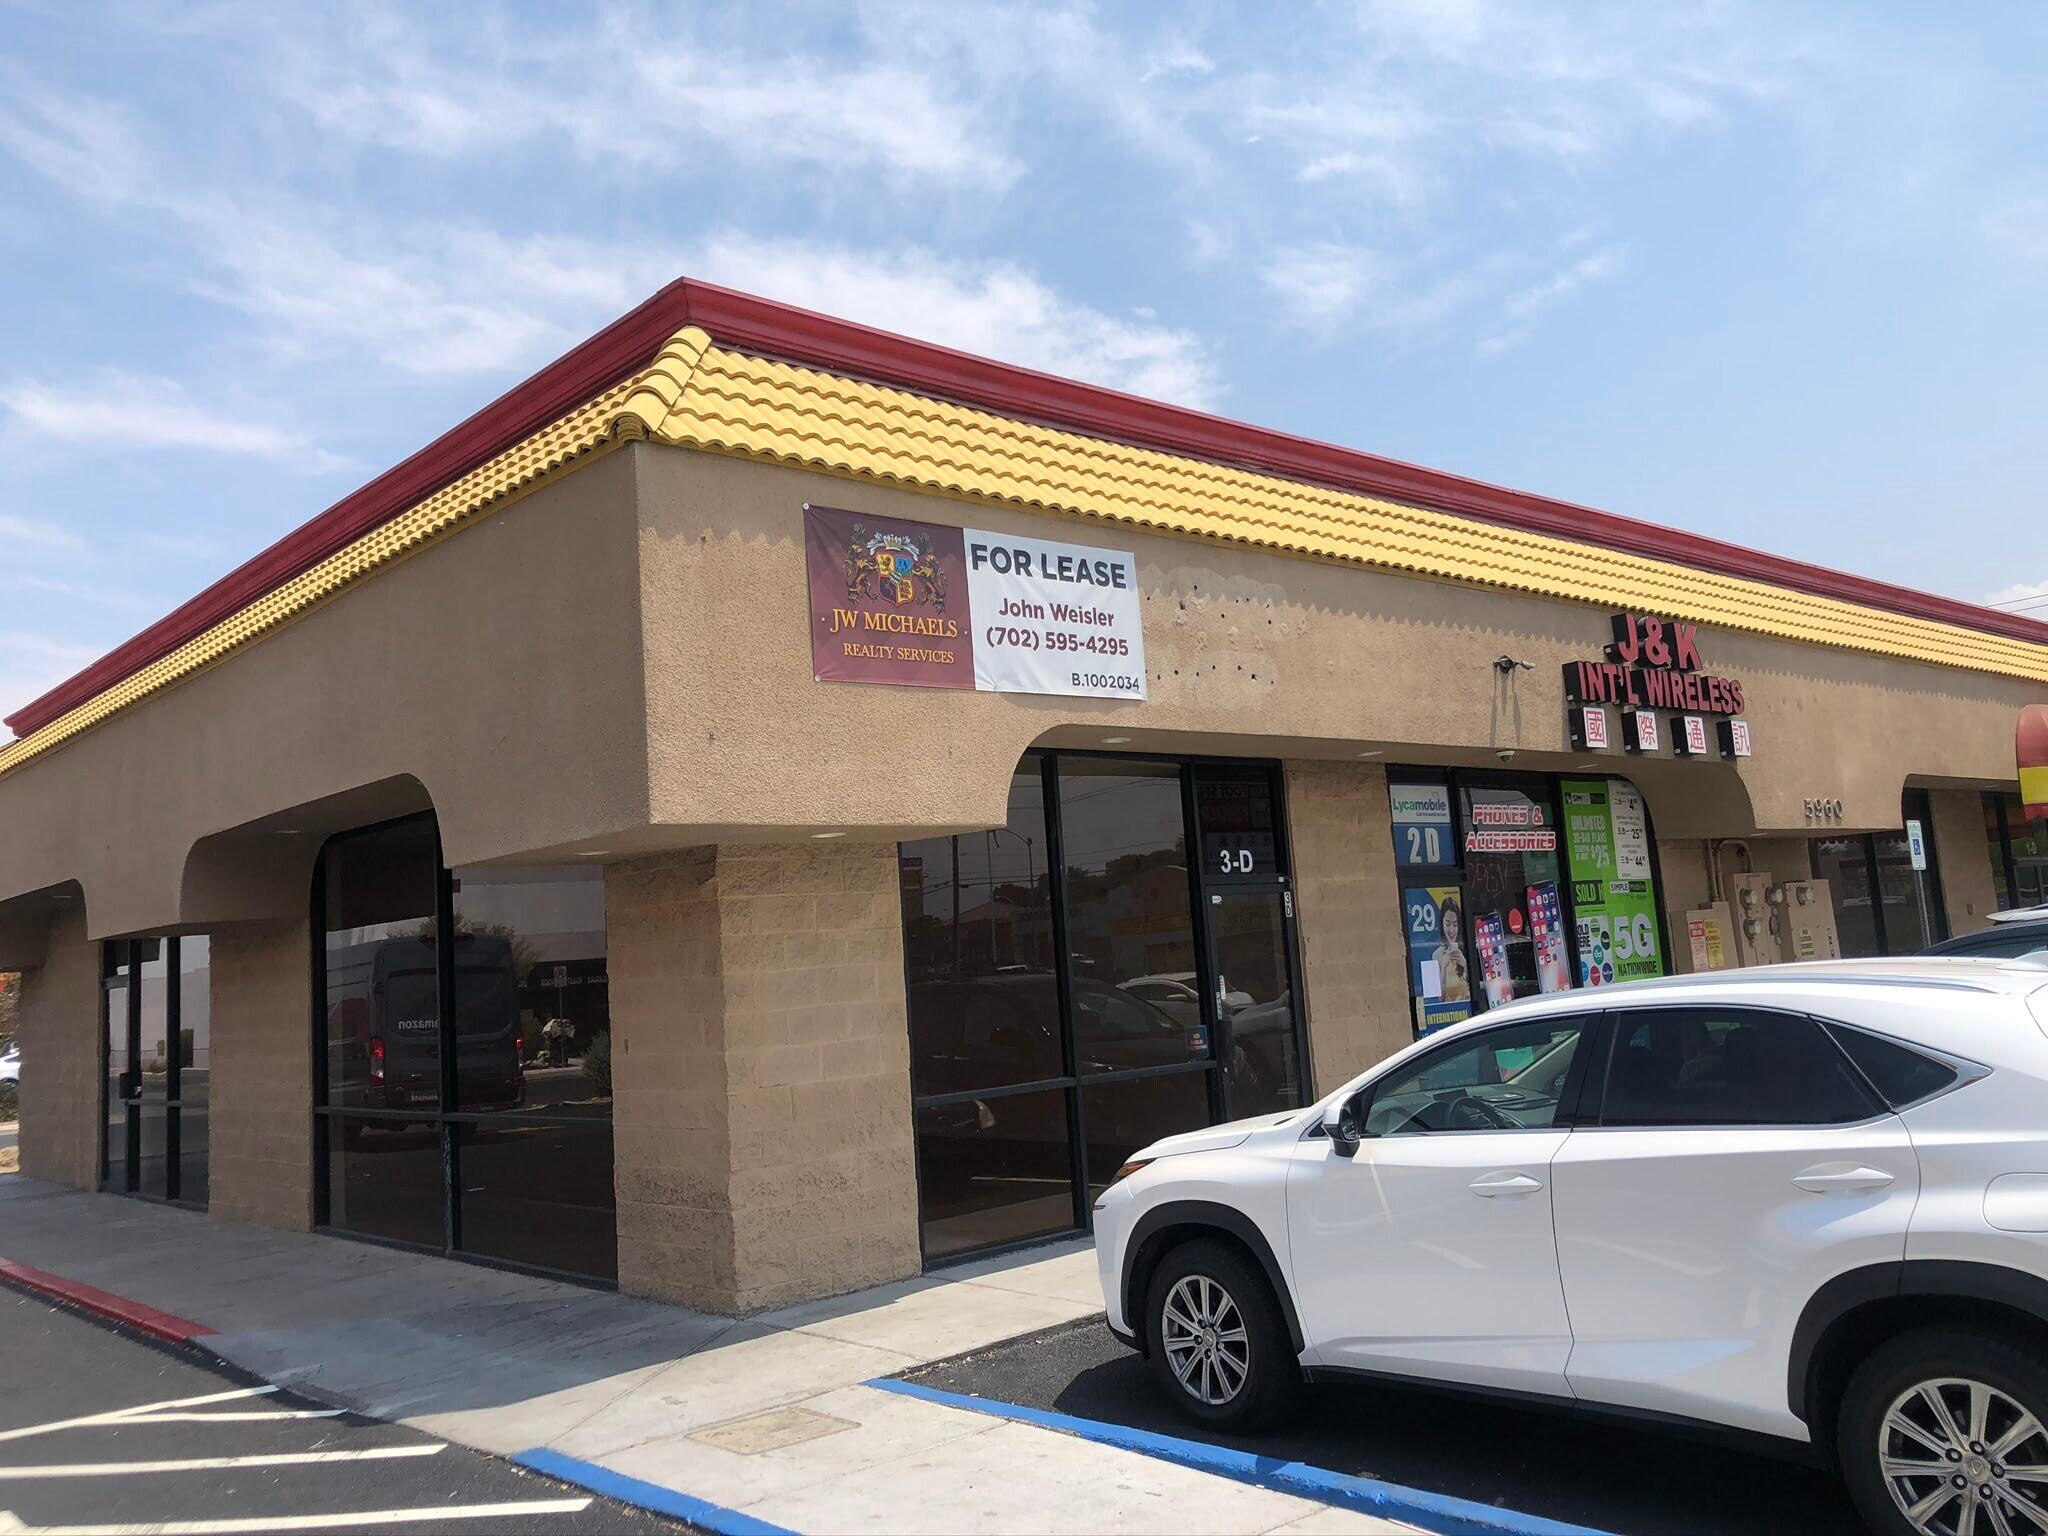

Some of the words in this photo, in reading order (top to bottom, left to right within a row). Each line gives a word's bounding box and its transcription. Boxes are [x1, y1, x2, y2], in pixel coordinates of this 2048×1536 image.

[970, 543, 1033, 578] FOR
[1040, 552, 1126, 590] LEASE
[998, 597, 1045, 620] John
[1049, 602, 1115, 627] Weisler
[829, 608, 858, 633] JW
[863, 611, 958, 638] MICHAELS
[986, 626, 1040, 651] (702)
[1045, 632, 1129, 656] 595-4295
[843, 642, 894, 659] REALTY
[897, 647, 955, 664] SERVICES
[1071, 672, 1140, 690] B.1002034
[1577, 661, 1640, 705] INT'L
[1643, 667, 1746, 716] WIRELESS
[1392, 798, 1446, 812] Lycamobile
[1473, 804, 1528, 825] PHONES
[1532, 805, 1544, 825] &
[1465, 831, 1556, 852] ACCESSORIES
[1220, 850, 1253, 873] 3-D
[1575, 884, 1597, 902] SOLD
[1610, 883, 1629, 892] SIMPLE
[1577, 924, 1590, 937] OLD
[1614, 914, 1656, 960] 5G
[1580, 936, 1591, 948] ERE
[1617, 961, 1658, 977] NATIONWIDE
[1427, 1009, 1469, 1025] INTERNATIONAL
